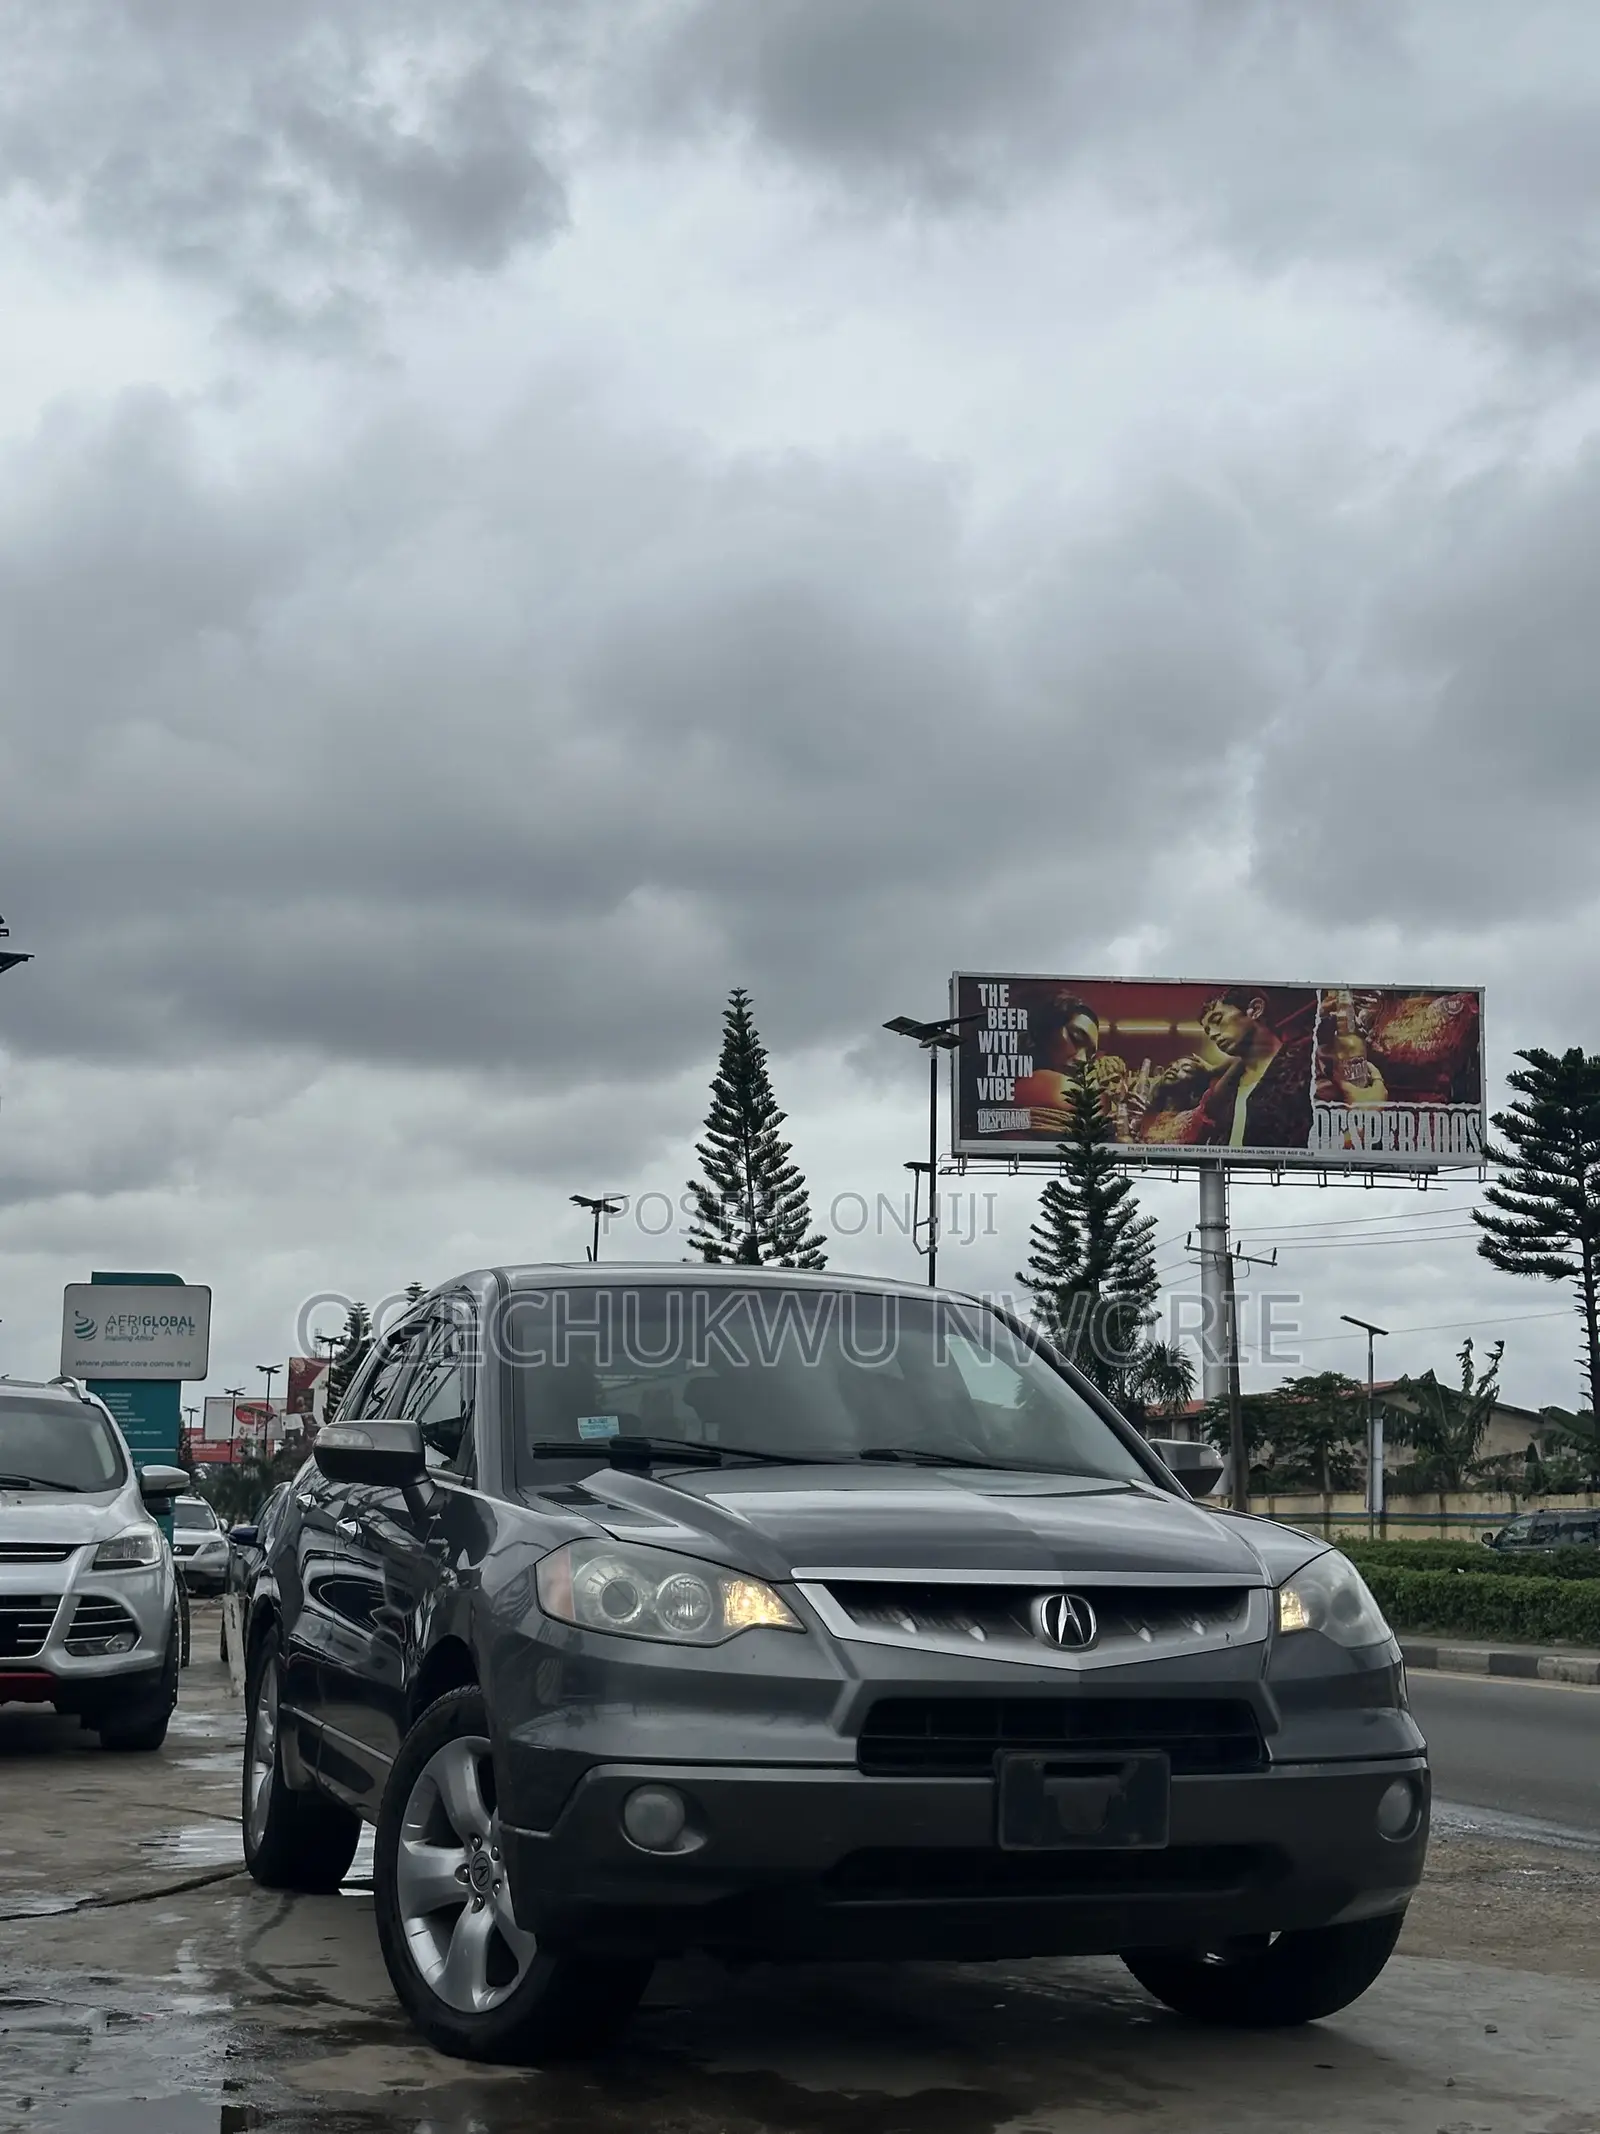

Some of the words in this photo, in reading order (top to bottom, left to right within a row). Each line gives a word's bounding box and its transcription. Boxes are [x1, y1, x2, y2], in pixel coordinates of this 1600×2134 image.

[978, 984, 1010, 1007] THE
[987, 1008, 1028, 1030] BEER
[978, 1031, 1018, 1053] WITH
[987, 1055, 1034, 1078] LATIN
[977, 1078, 1016, 1101] VIBE
[978, 1109, 1031, 1132] DESPERADOS
[1308, 1107, 1482, 1153] DESPERADOS
[105, 1326, 196, 1336] MEDICARE
[107, 1315, 196, 1328] AFRIGLOBAL
[101, 1360, 129, 1368] patient
[176, 1360, 191, 1368] first
